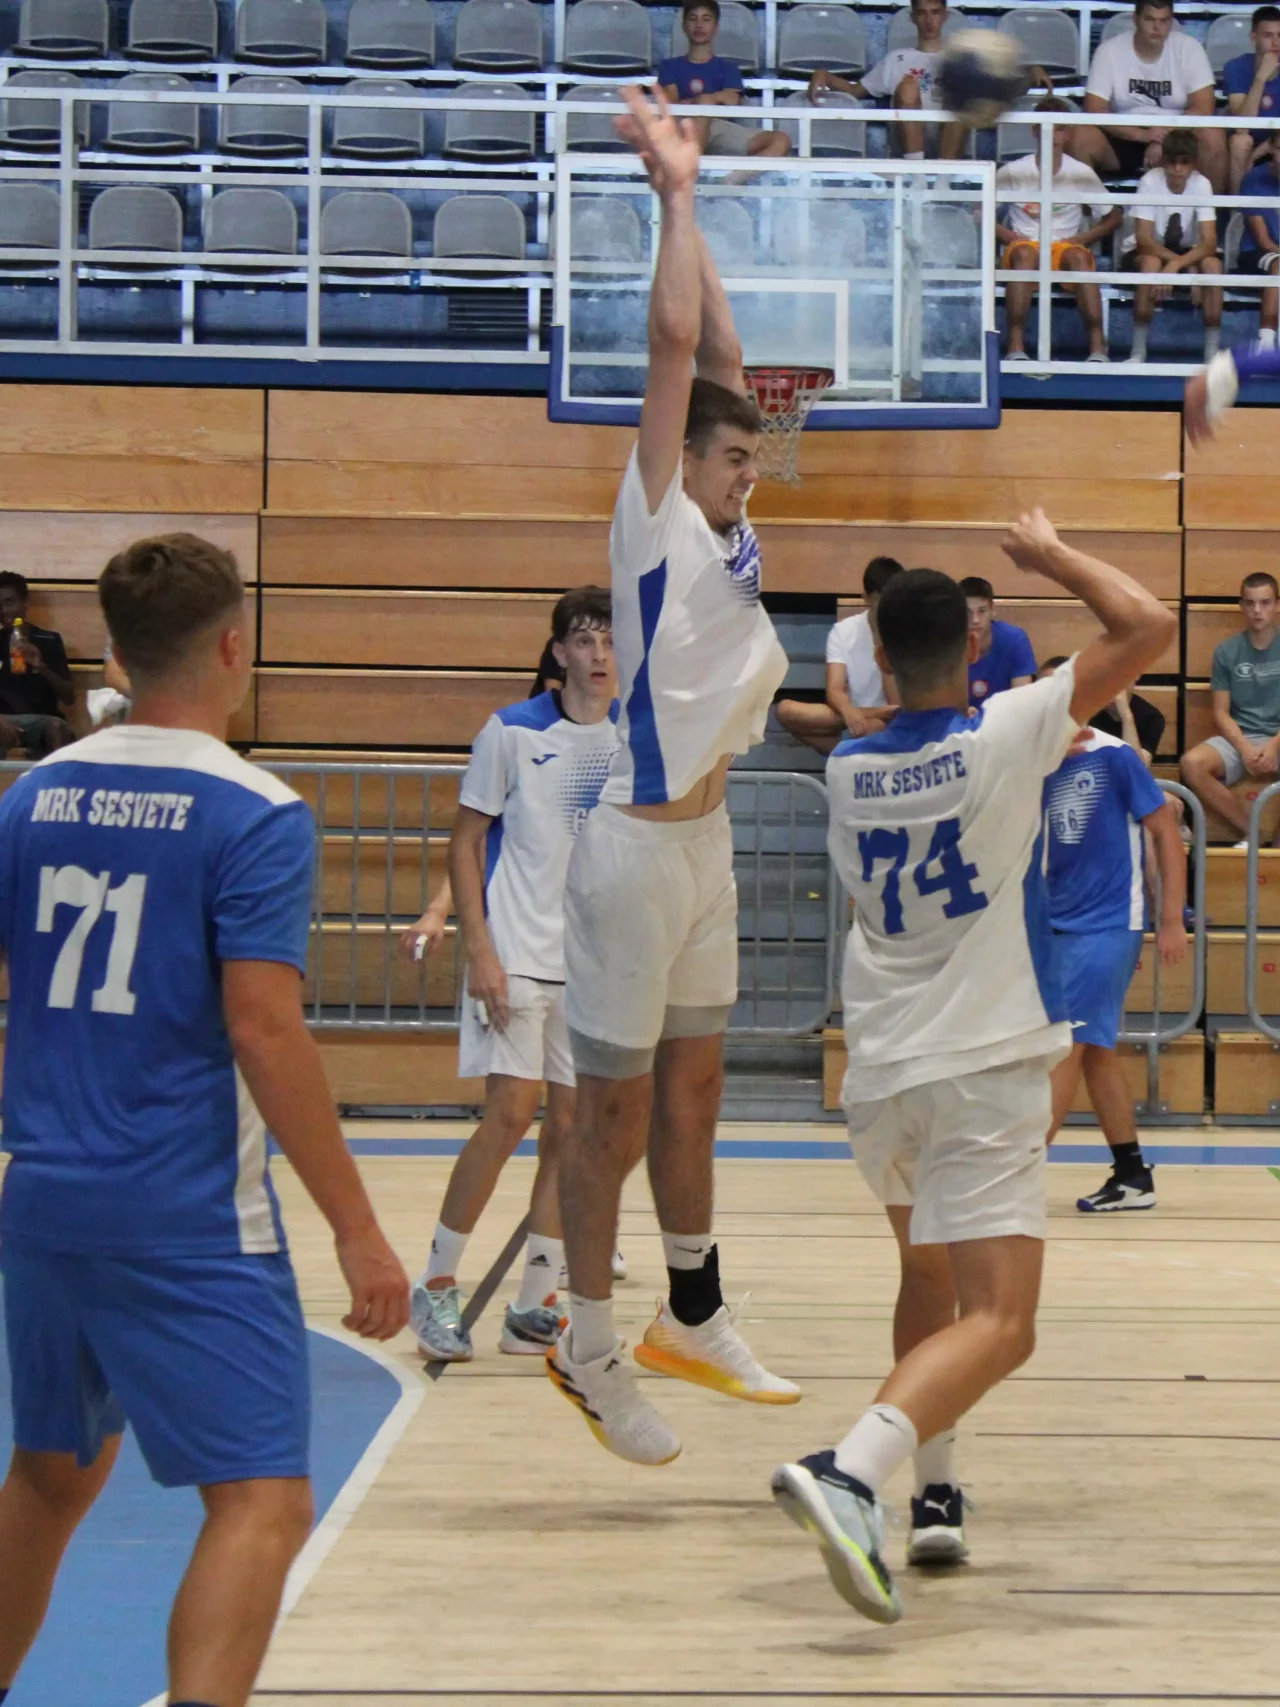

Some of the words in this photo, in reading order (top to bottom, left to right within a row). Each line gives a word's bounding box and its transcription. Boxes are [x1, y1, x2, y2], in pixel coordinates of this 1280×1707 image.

[854, 771, 888, 800] MRK
[890, 750, 967, 796] SESVETE
[31, 787, 86, 823] MRK
[86, 788, 195, 832] SESVETE
[1055, 808, 1079, 835] 66
[856, 816, 990, 936] 74
[35, 864, 148, 1016] 71
